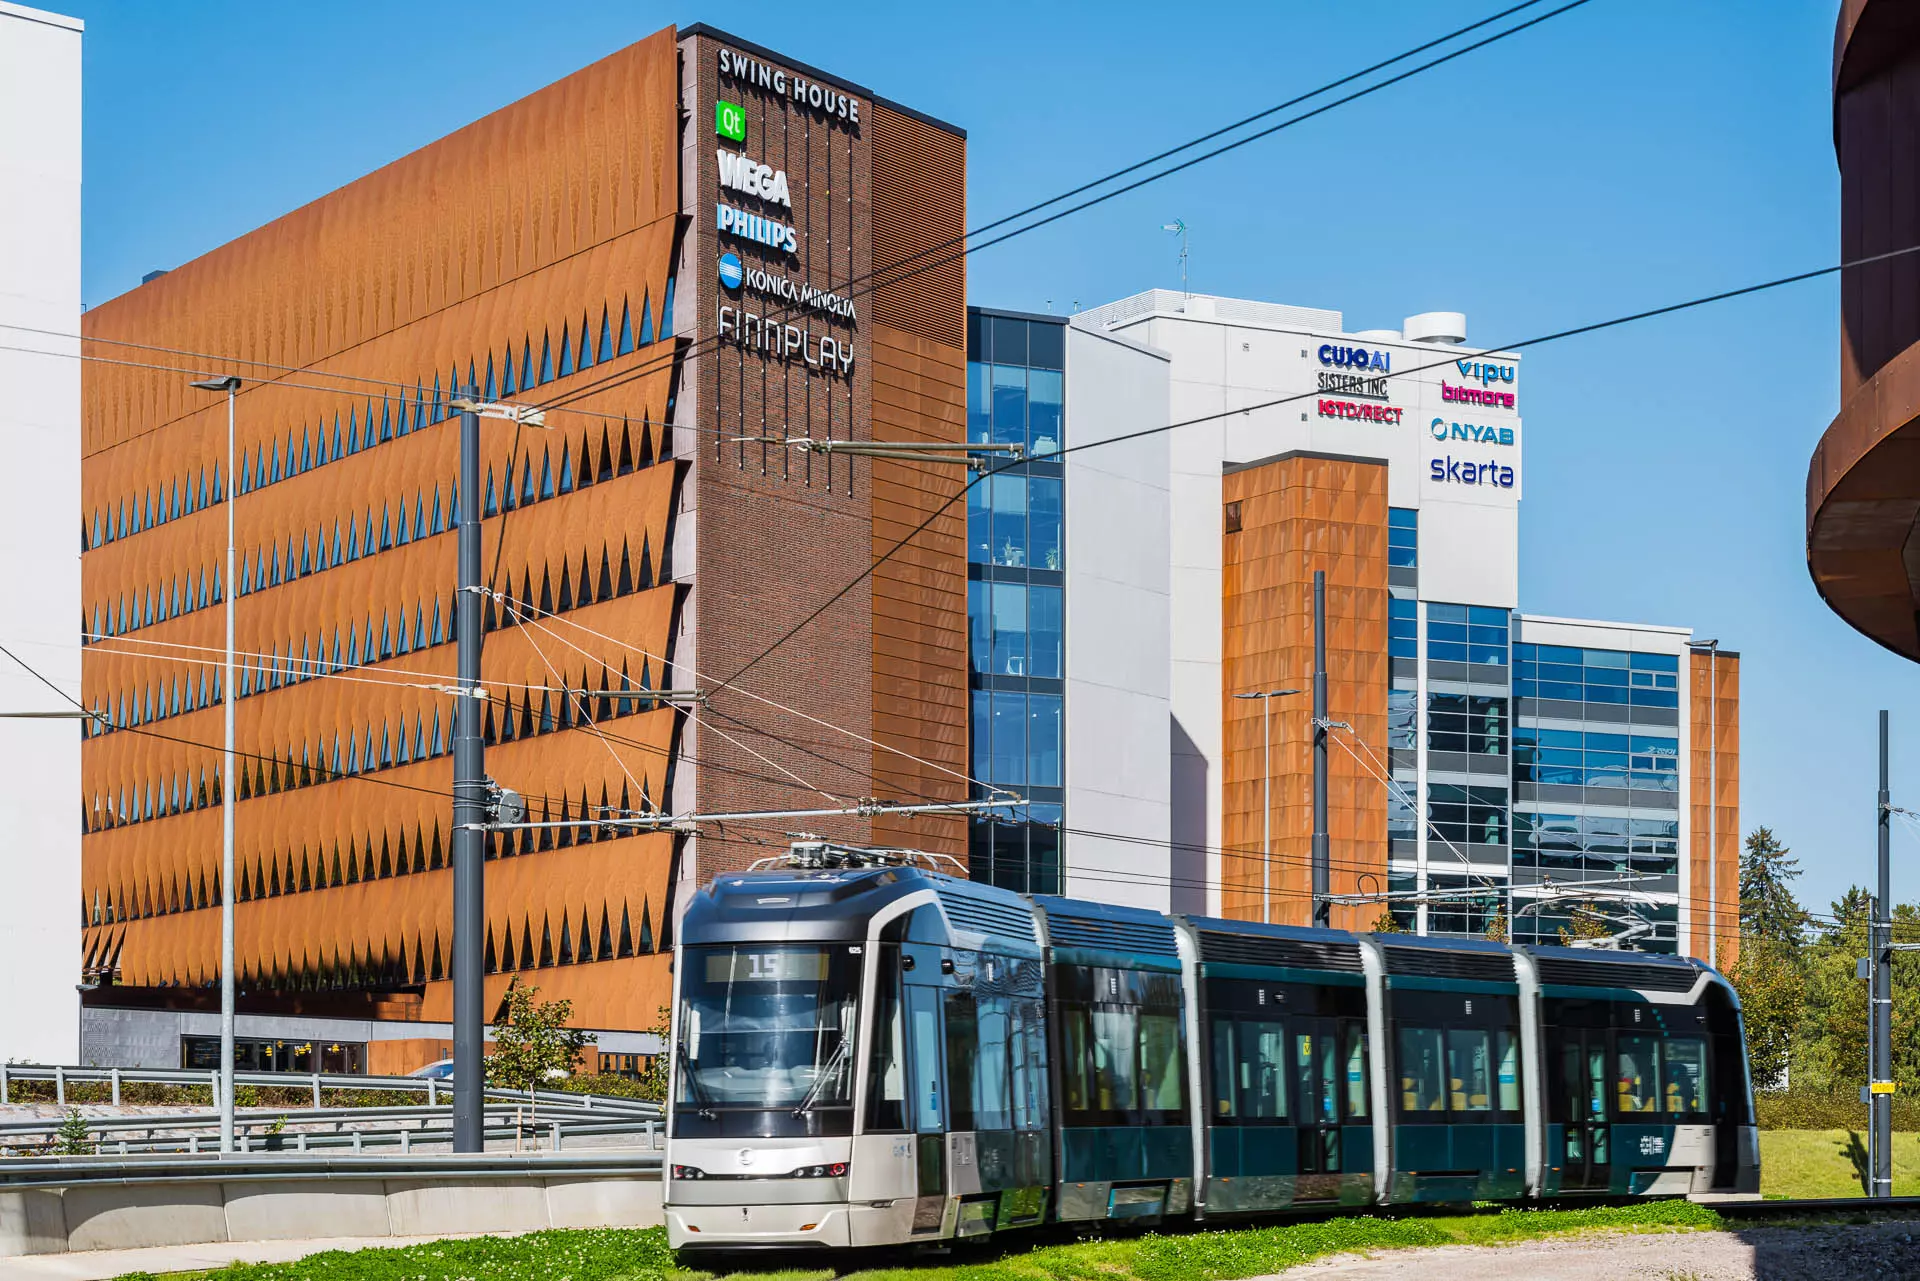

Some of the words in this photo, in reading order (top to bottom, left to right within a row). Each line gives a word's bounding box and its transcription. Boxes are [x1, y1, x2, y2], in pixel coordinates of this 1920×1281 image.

[719, 49, 786, 94] SWING
[794, 77, 859, 123] HOUSE
[723, 107, 741, 135] Qt
[717, 149, 791, 207] WEGA
[717, 203, 797, 253] PHILIPS
[746, 267, 798, 300] KONICA
[801, 284, 857, 319] MINOLTA
[1318, 344, 1369, 368] CUJO
[1369, 351, 1390, 372] AI
[1318, 372, 1363, 393] SISTERS
[1367, 377, 1388, 395] INC
[1456, 360, 1514, 385] vipu
[1442, 380, 1514, 406] bitmore
[1452, 422, 1514, 445] NYAB
[1431, 455, 1514, 487] skarta
[748, 954, 781, 978] 15
